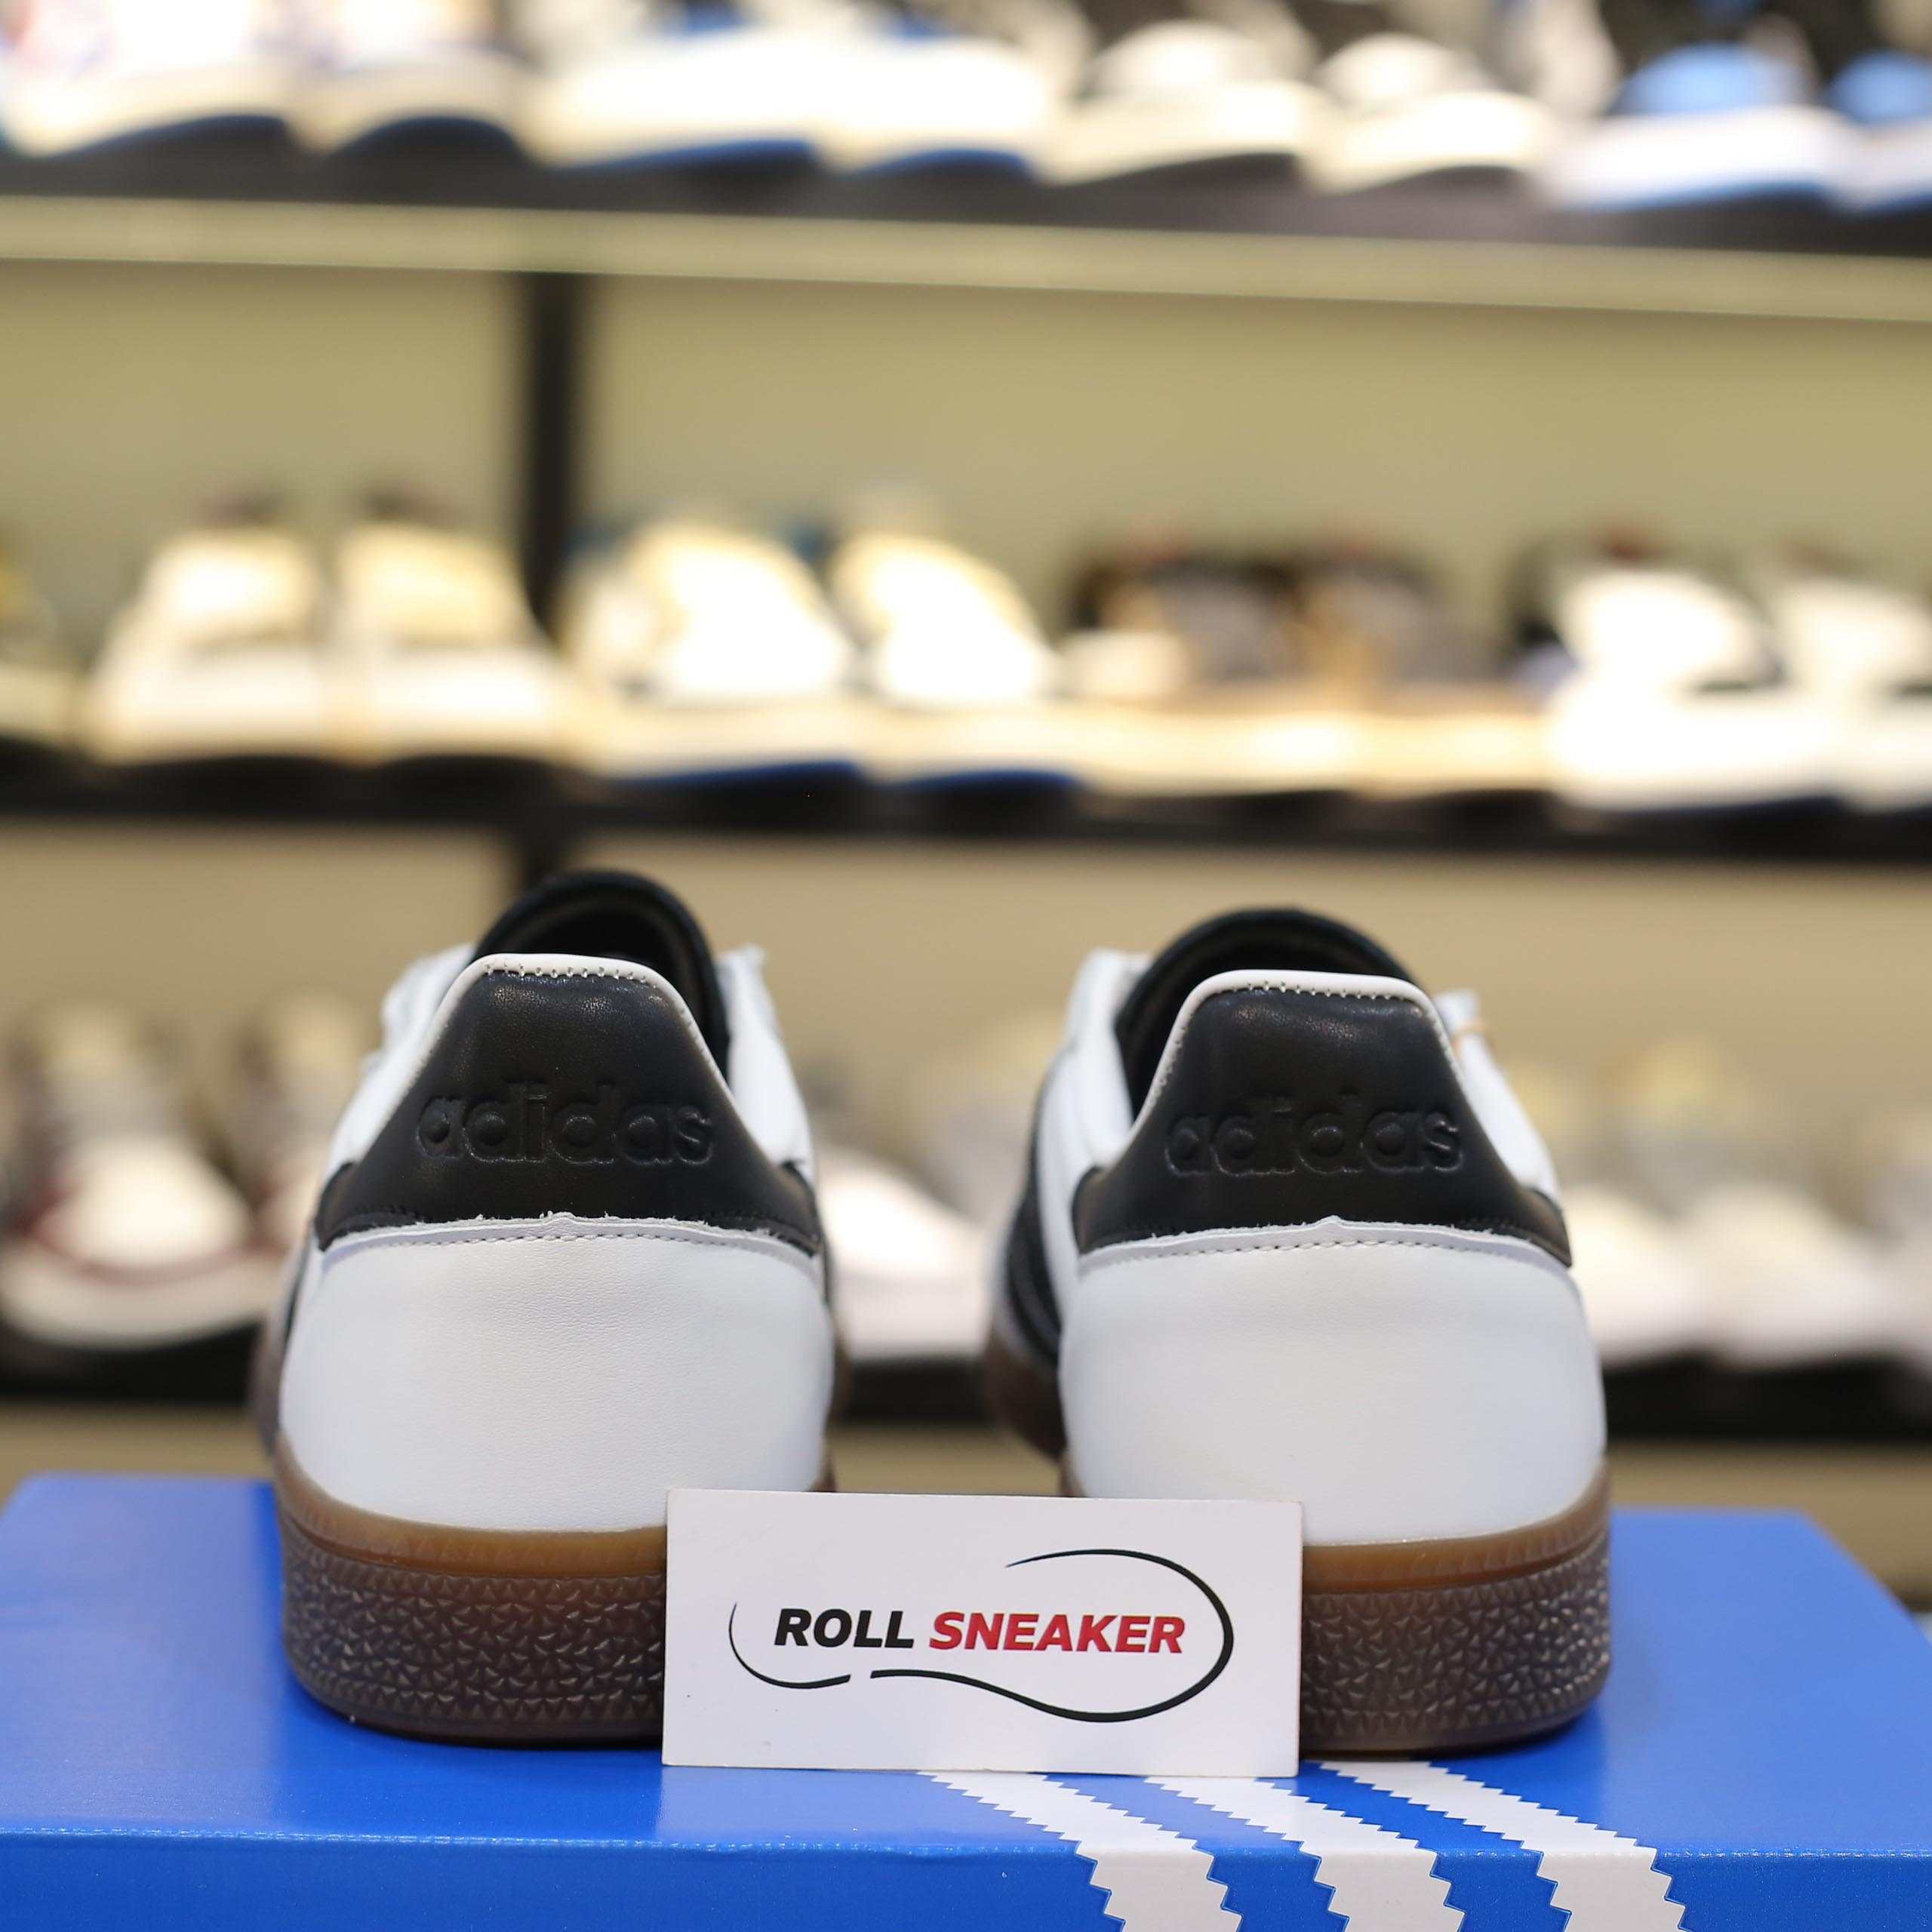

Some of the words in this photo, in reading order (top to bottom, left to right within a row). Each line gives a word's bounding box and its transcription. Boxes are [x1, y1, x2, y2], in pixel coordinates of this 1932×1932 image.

[416, 1080, 714, 1166] adidas
[1164, 1093, 1464, 1177] adidas
[774, 1607, 915, 1650] ROLL
[928, 1611, 1186, 1655] SNEAKER
